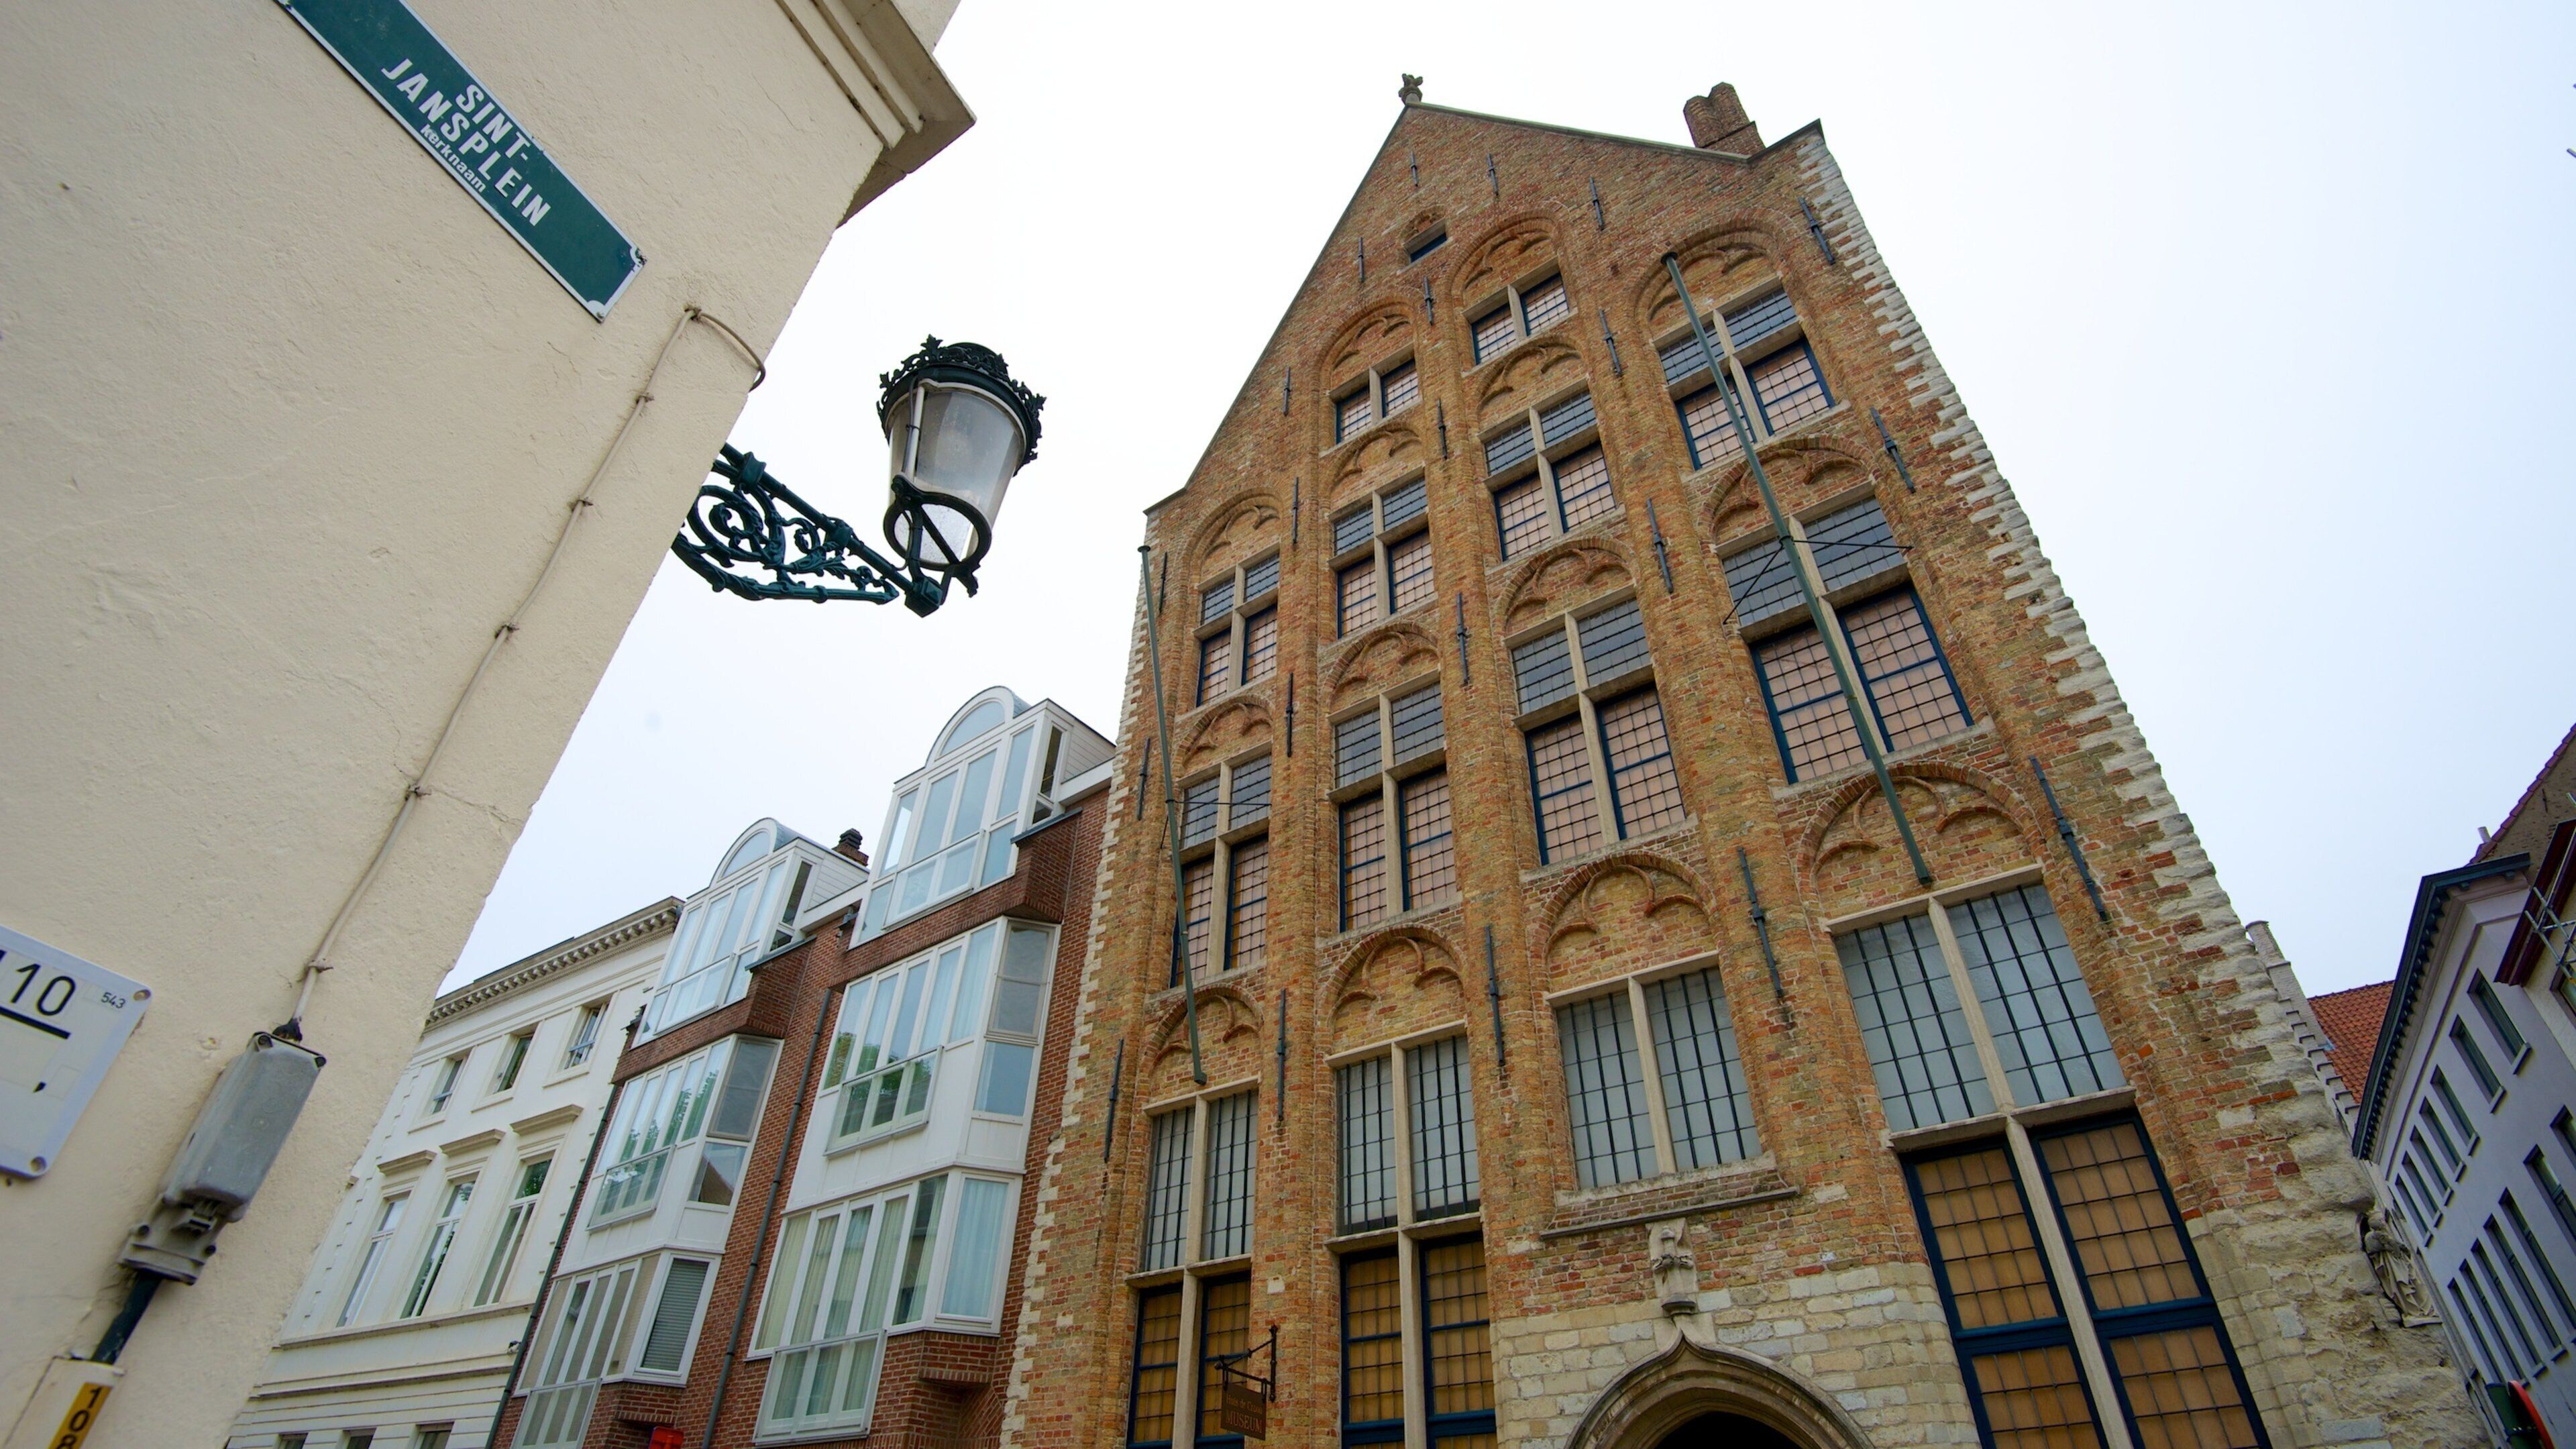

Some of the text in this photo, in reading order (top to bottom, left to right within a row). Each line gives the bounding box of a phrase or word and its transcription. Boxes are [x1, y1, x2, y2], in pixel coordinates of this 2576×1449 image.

[381, 58, 551, 226] JANSPLEIN
[455, 84, 530, 160] SINT-
[420, 124, 486, 193] kerknaam
[101, 991, 125, 1009] 543
[1225, 1410, 1263, 1433] MUSEUM
